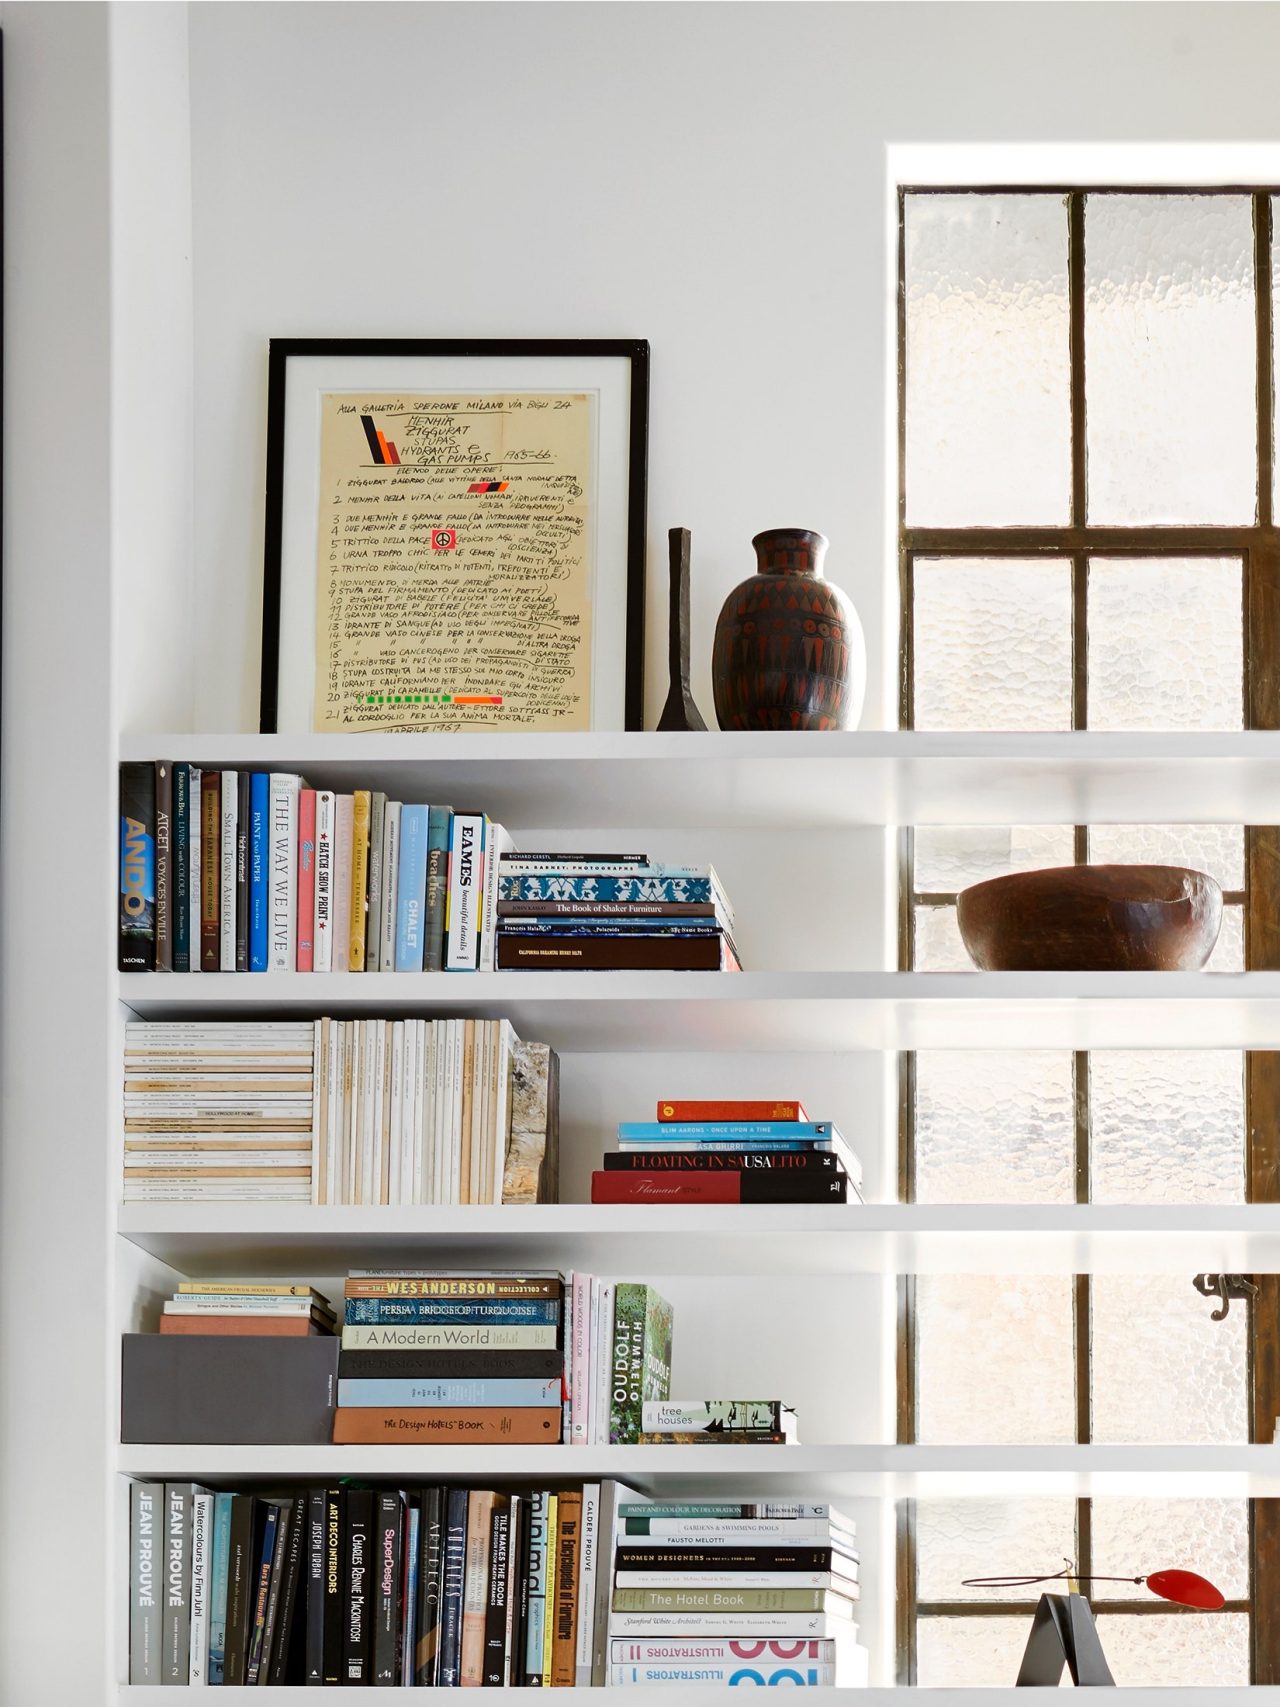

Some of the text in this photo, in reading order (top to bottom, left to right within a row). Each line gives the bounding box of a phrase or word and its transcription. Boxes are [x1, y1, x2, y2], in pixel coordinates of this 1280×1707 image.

[362, 401, 405, 413] GALLERIA
[413, 402, 460, 410] SPERONE
[467, 400, 503, 409] MILANO
[508, 400, 523, 409] VIA
[404, 425, 470, 436] ZIGGURAT
[408, 415, 455, 426] MENHIR
[401, 446, 460, 456] HYDRANTS
[414, 436, 456, 445] STUPAS
[418, 454, 491, 465] GAS PUMPS
[362, 513, 398, 522] MENHIR
[412, 514, 443, 522] GRANDE
[343, 715, 354, 723] AL
[358, 713, 405, 721] CORDOGLIO
[461, 711, 488, 719] ANIMA
[125, 817, 145, 916] ANDO
[157, 811, 169, 940] ATGET VOYAGES EN VILLE
[274, 796, 289, 951] THE WAY WE LIVE
[318, 842, 329, 920] HATCH SHOW PRINT
[429, 850, 441, 907] beaches
[459, 825, 474, 951] EAMES beautiful details
[407, 900, 418, 948] CHALET
[556, 904, 662, 913] The Book of Shaker Furniture
[386, 1281, 495, 1296] WES ANDERSON
[366, 1330, 379, 1345] A
[382, 1330, 441, 1345] Modern
[444, 1330, 491, 1345] World
[614, 1321, 629, 1402] OUDOLF
[630, 1322, 642, 1401] HUMMELO
[658, 1413, 692, 1425] houses
[662, 1407, 682, 1416] tree
[139, 1491, 155, 1606] JEAN PROUVÉ
[194, 1501, 205, 1617] Watercolours by Finn Juhl
[289, 1499, 304, 1563] GREAT ESCAPES
[312, 1521, 322, 1578] JOSEPH URBAN
[328, 1503, 338, 1594] ART DECO INTERIORS
[496, 1514, 508, 1606] TILE MAKES THE ROOM
[584, 1501, 594, 1572] CALDER PROUVÉ
[168, 1491, 184, 1676] JEAN PROUVÉ 2
[350, 1533, 366, 1642] CHARLES RENNIE MACKINTOSH
[381, 1529, 395, 1595] SuperDesign
[559, 1521, 576, 1640] The Encyclopedia of Furniture
[650, 1593, 673, 1605] The
[676, 1594, 708, 1605] Hotel
[713, 1594, 744, 1605] Book
